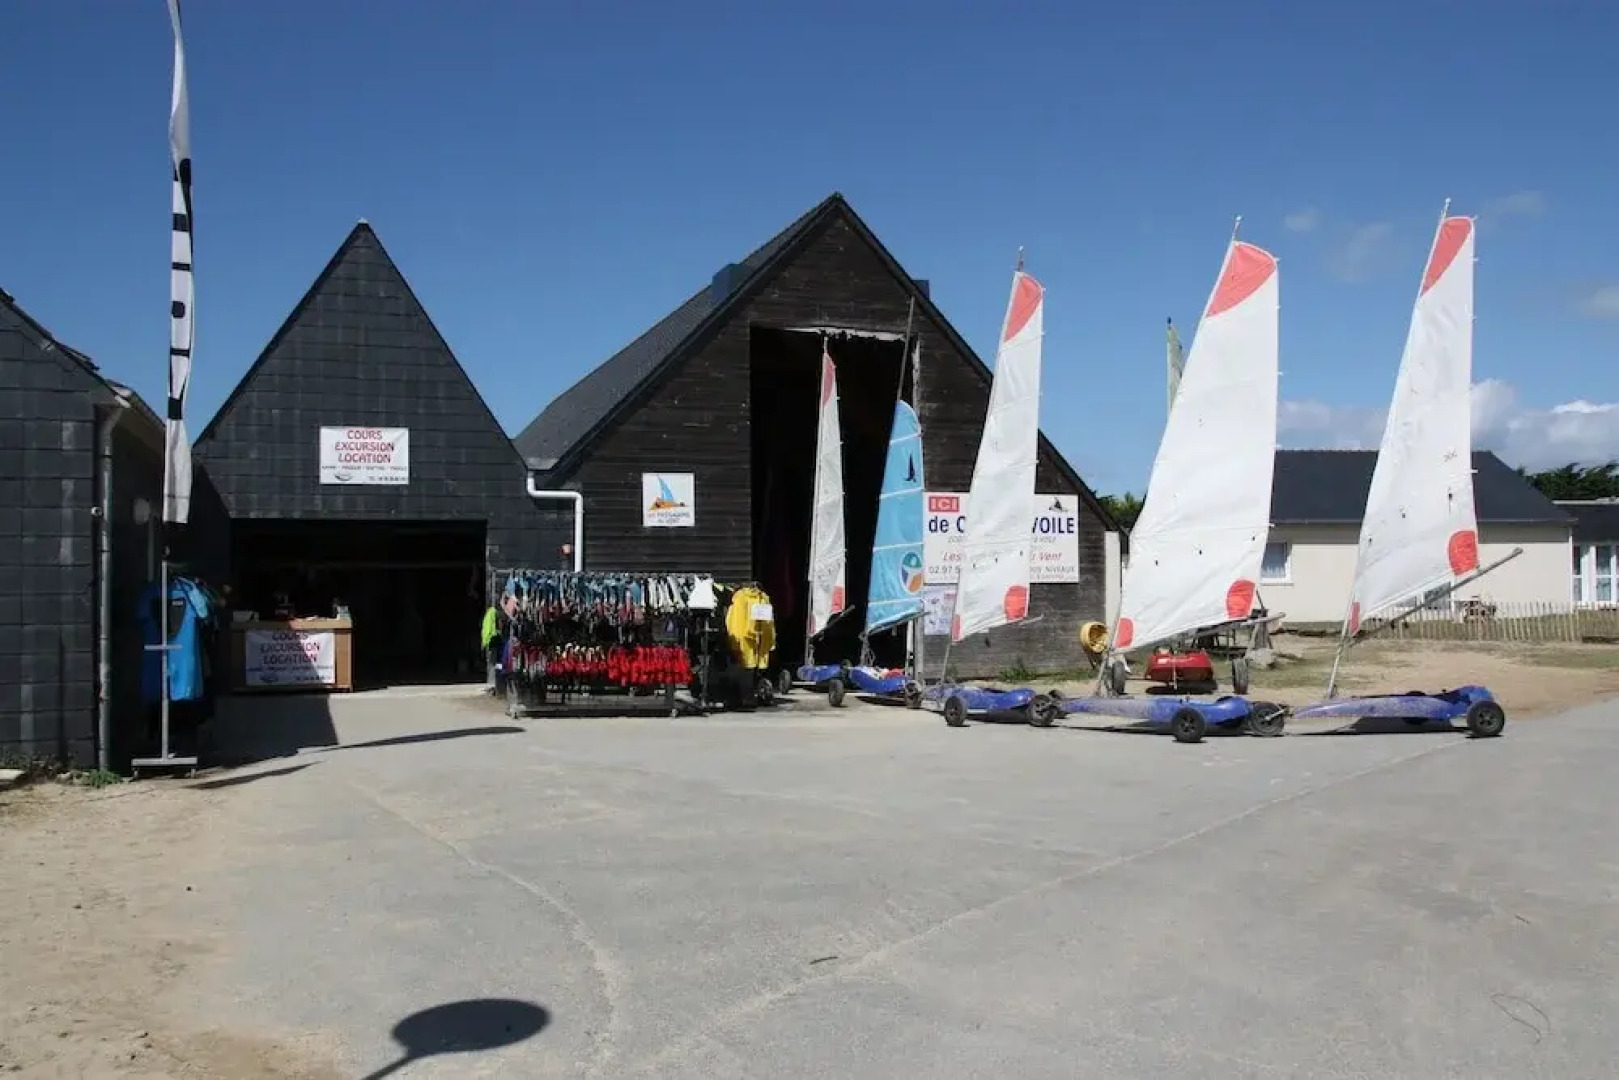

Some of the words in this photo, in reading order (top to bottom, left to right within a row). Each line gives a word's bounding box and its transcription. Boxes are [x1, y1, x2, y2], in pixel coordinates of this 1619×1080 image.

[347, 430, 382, 440] COURS
[335, 441, 394, 452] EXCURSION
[338, 453, 391, 463] LOCATION
[931, 498, 958, 510] ICI
[928, 515, 949, 533] de
[260, 642, 320, 653] EXCURSION
[263, 653, 317, 664] LOCATION
